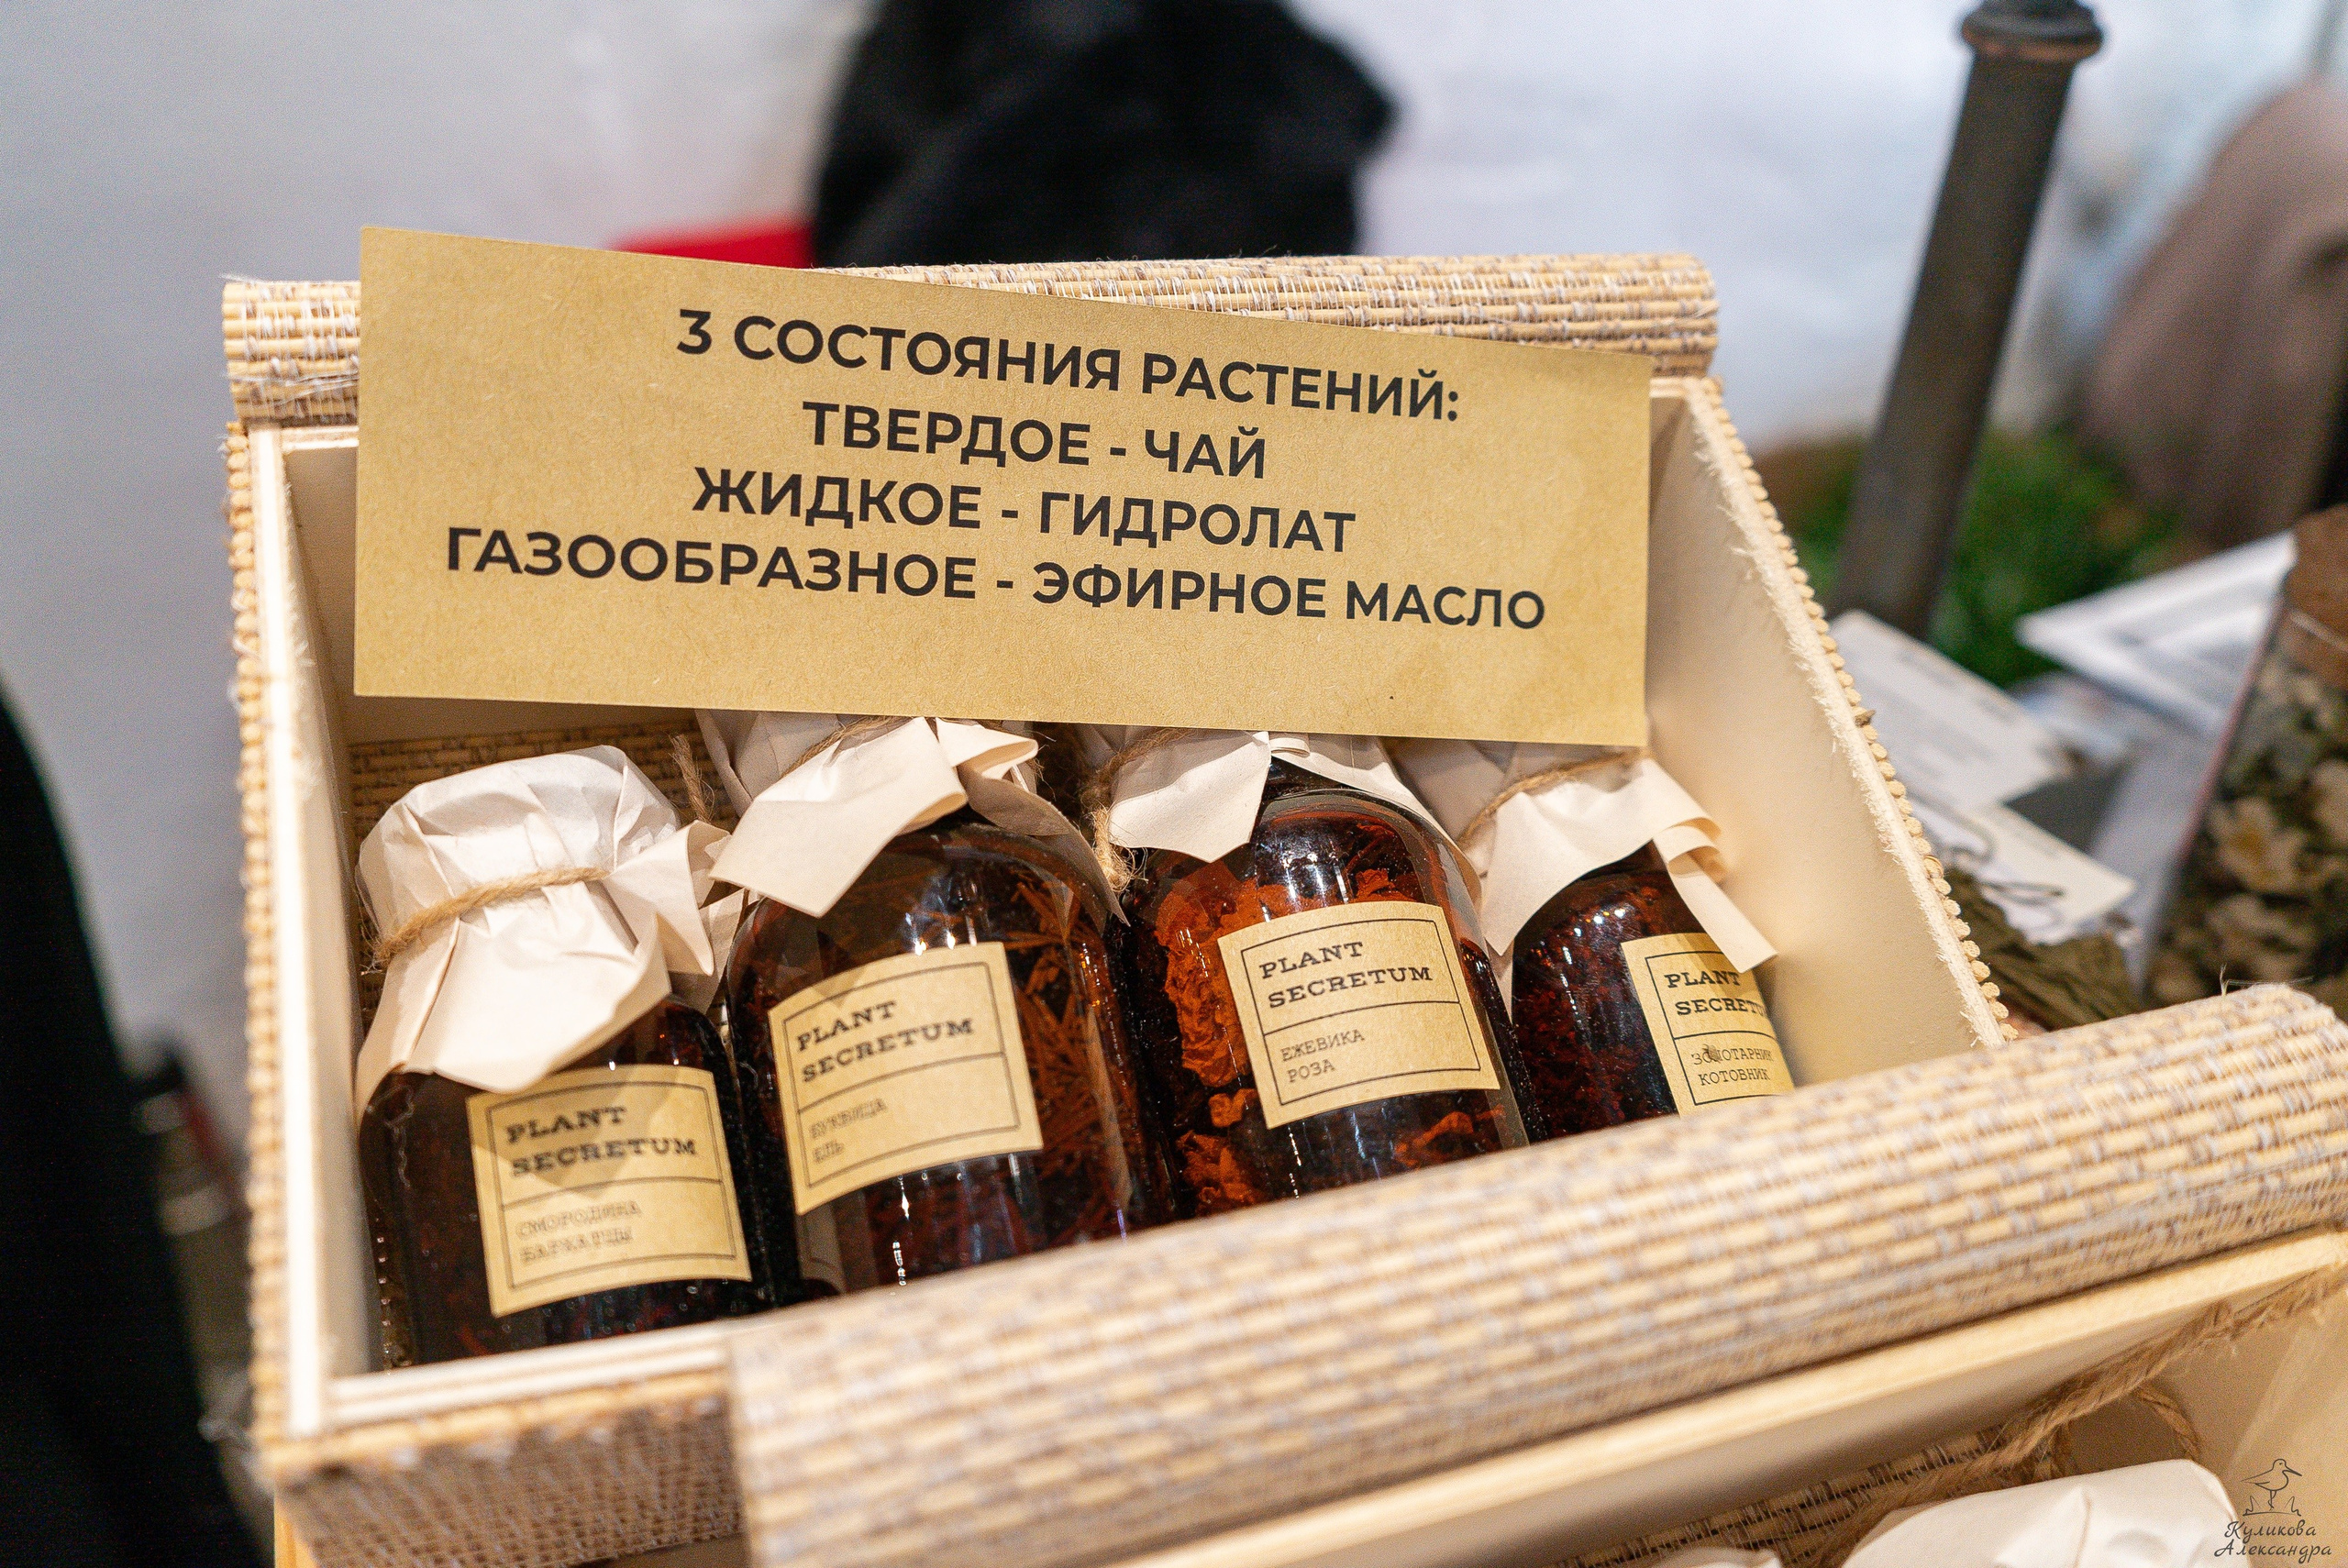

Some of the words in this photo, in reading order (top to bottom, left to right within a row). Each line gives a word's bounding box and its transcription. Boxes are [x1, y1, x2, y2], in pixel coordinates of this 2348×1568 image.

[676, 308, 713, 355] 3
[734, 315, 1121, 392] СОСТОЯНИЯ
[1142, 352, 1458, 422] РАСТЕНИЙ:
[802, 401, 1091, 468] ТВЕРДОЕ
[1109, 446, 1127, 457] -
[1145, 425, 1266, 479] ЧАЙ
[692, 466, 981, 529] ЖИДКОЕ
[1001, 509, 1019, 519] -
[1040, 491, 1357, 553] ГИДРОЛАТ
[447, 526, 977, 599] ГАЗООБРАЗНОЕ
[996, 580, 1013, 589] -
[1033, 561, 1326, 618] ЭФИРНОЕ
[1346, 580, 1545, 630] МАСЛО
[1258, 941, 1364, 979] PLANT
[1663, 969, 1741, 988] PLANT
[1268, 966, 1434, 1009] SECRETUM
[796, 1000, 897, 1052] PLANT
[1280, 1029, 1366, 1063] ЕЖЕВИКА
[801, 1018, 975, 1083] SECRETUM
[1287, 1060, 1335, 1084] РОЗА
[1698, 1068, 1771, 1087] КОТОВНИК
[507, 1106, 627, 1144] PLANT
[512, 1137, 696, 1177] SECRETUM
